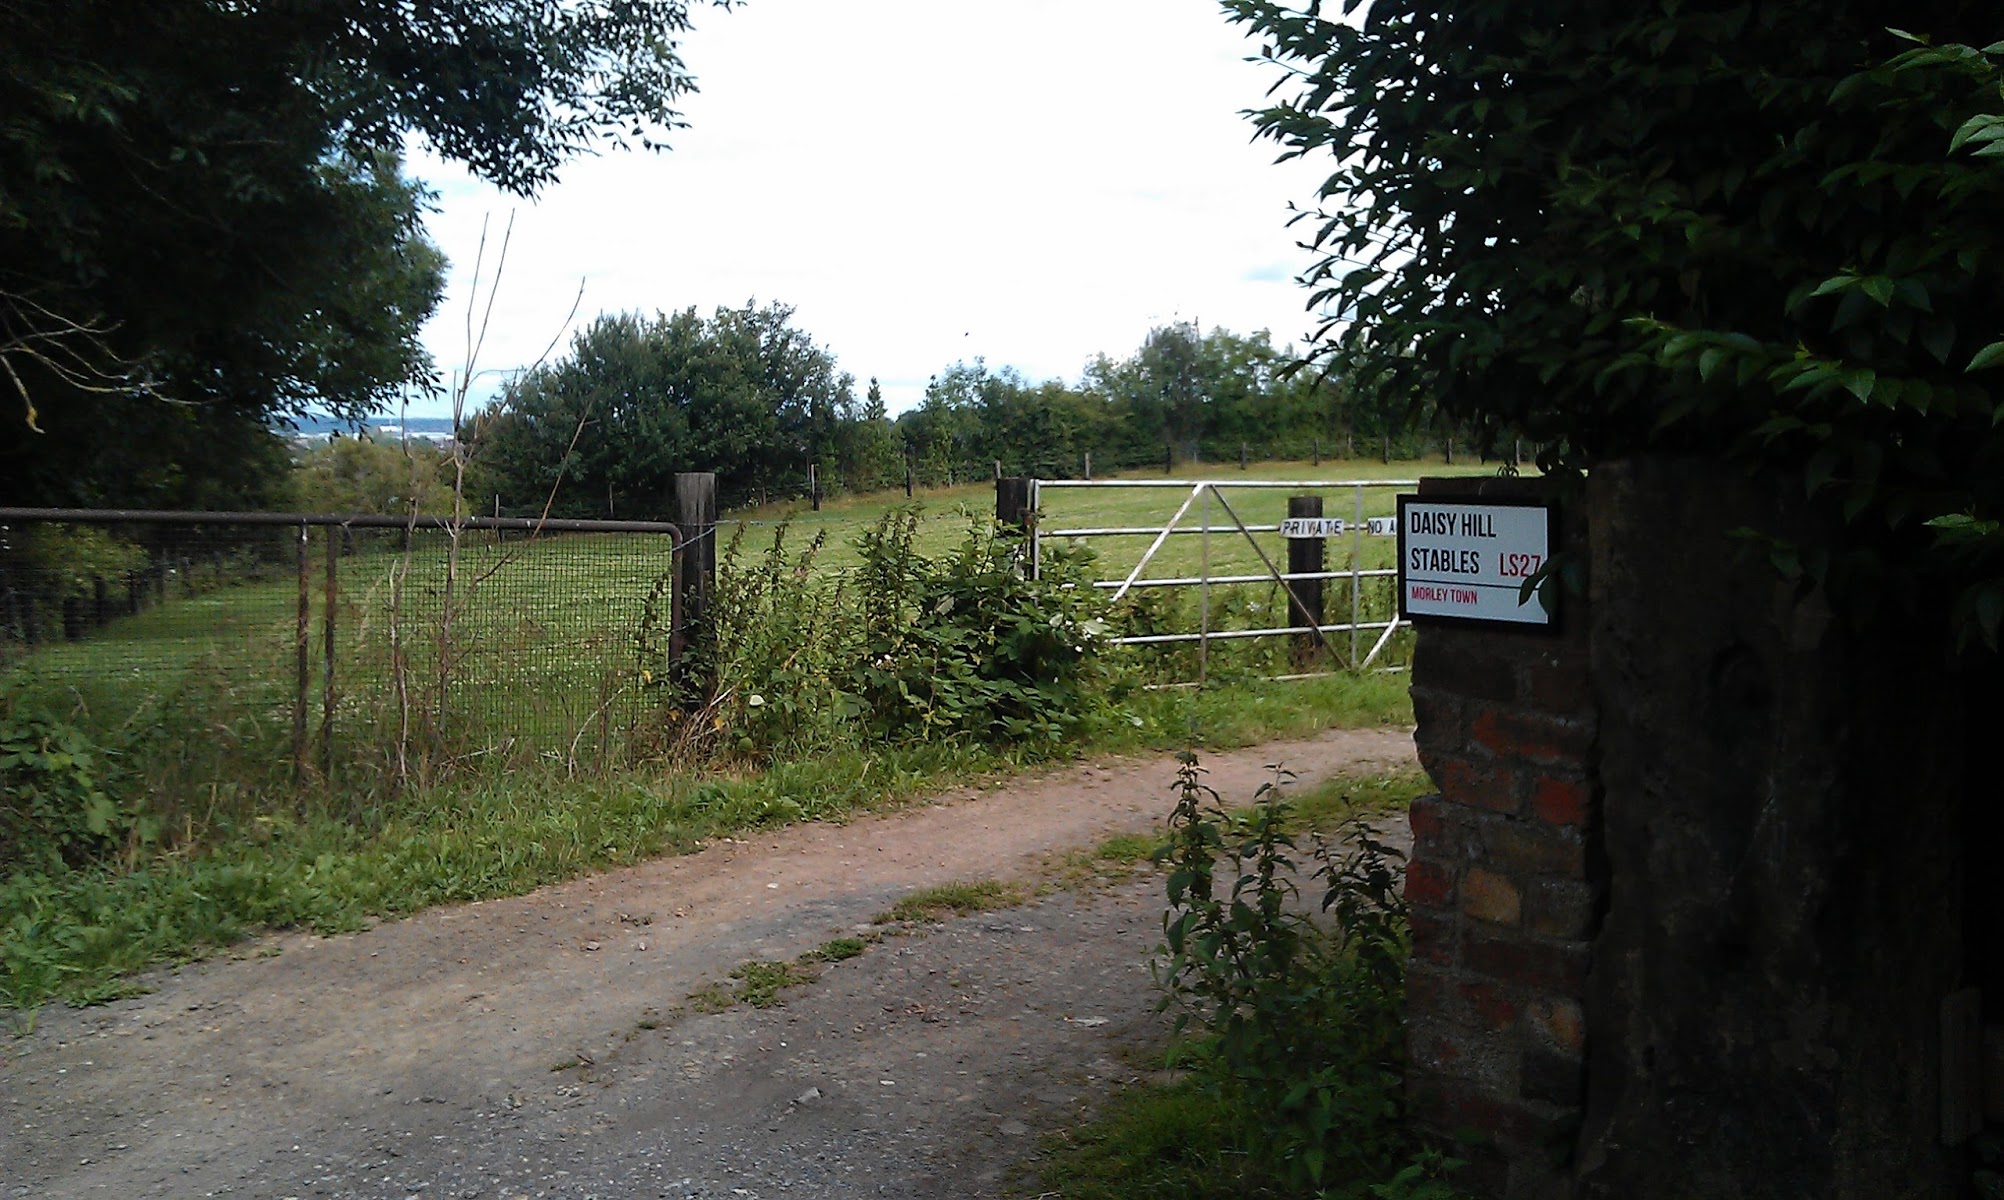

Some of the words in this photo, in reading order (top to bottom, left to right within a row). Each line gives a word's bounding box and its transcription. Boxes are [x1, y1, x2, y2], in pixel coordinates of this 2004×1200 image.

[1282, 520, 1342, 535] PRIVATE
[1367, 520, 1383, 534] NO
[1411, 511, 1457, 536] DAISY
[1461, 513, 1497, 538] HILL
[1411, 547, 1480, 575] STABLES
[1499, 552, 1541, 577] LS27
[1411, 586, 1448, 602] MORLEY
[1450, 588, 1478, 604] TOWN
